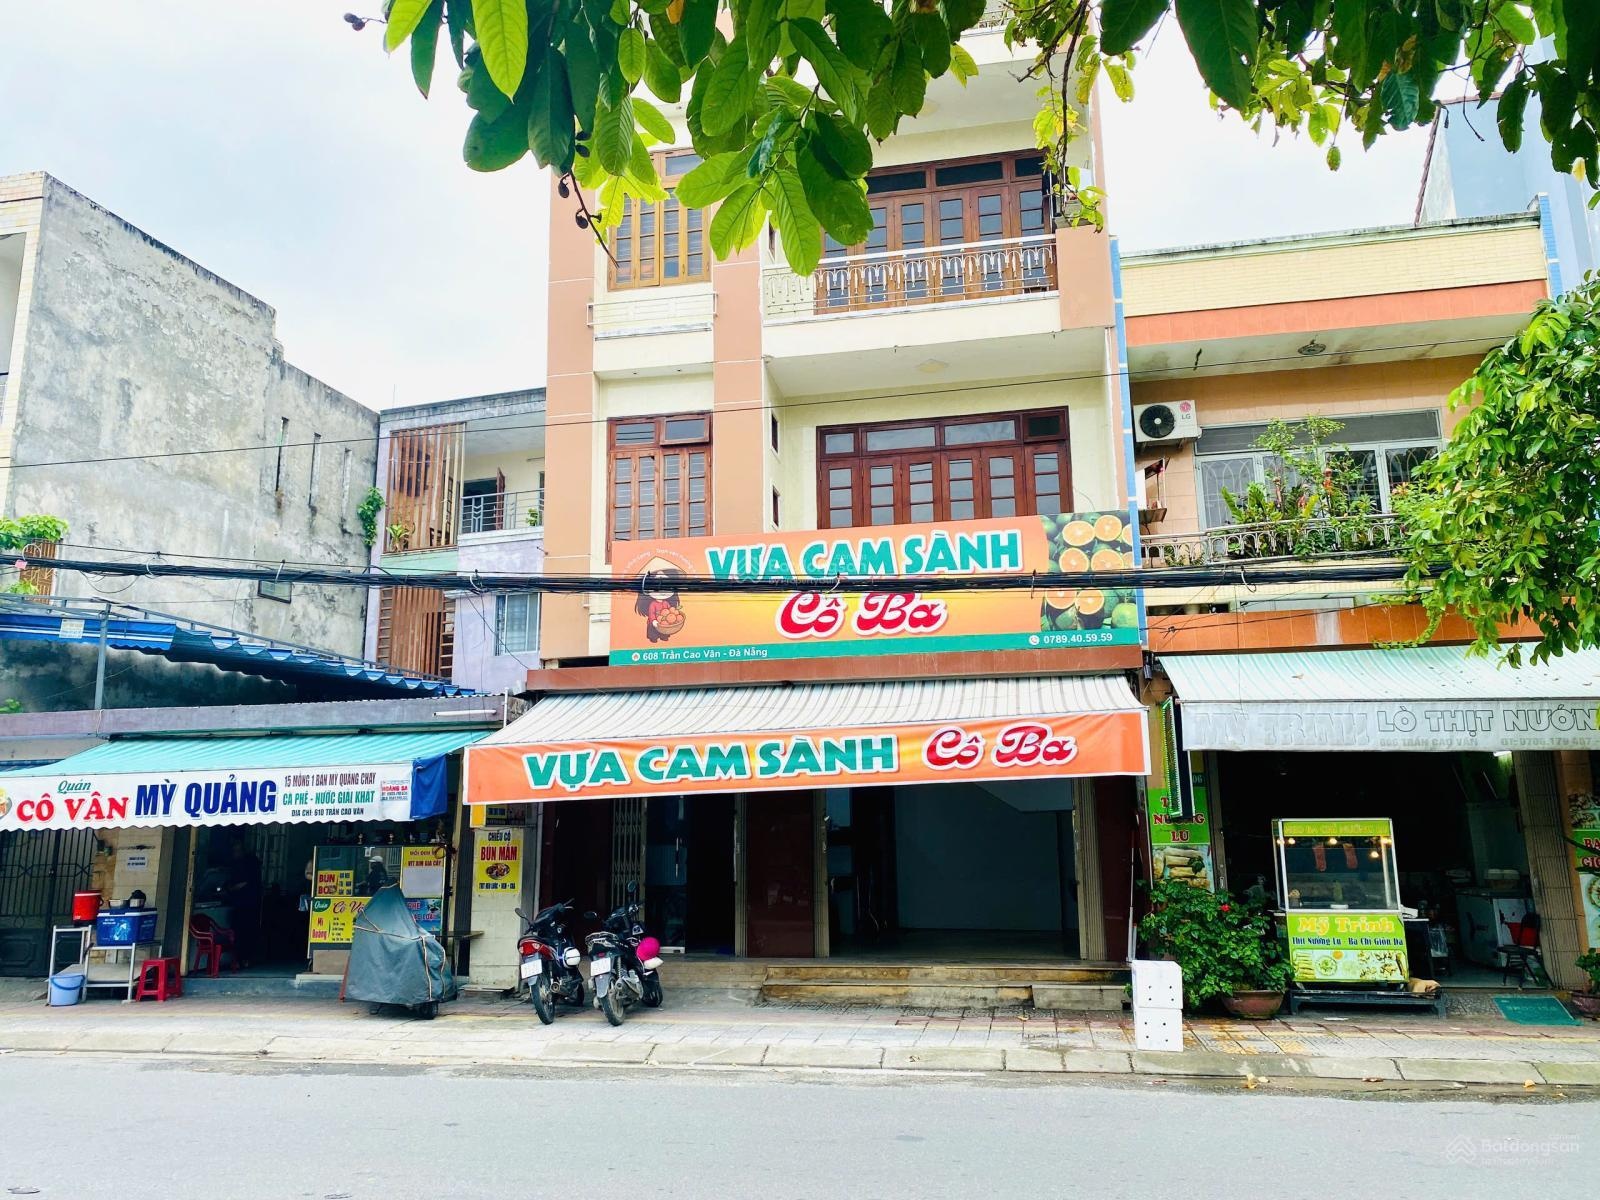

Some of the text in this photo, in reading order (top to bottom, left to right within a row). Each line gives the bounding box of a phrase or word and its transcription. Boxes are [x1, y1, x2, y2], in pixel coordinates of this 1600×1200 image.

[803, 540, 895, 579] CAM
[904, 533, 1019, 573] SÀNH
[780, 591, 842, 634] Cô
[643, 653, 659, 661] 608
[683, 651, 701, 659] Cao
[703, 648, 720, 659] Vân
[1043, 633, 1113, 645] 0789.40.59.59
[1376, 706, 1417, 733] LÒ
[1425, 710, 1494, 737] THỊT
[926, 725, 1073, 767] Cô Ba
[526, 737, 894, 789] VỰA CAM SÀNH
[57, 779, 92, 794] Quán
[134, 773, 277, 818] MỲ QUẢNG
[16, 790, 129, 822] CÔ VÂN
[480, 844, 497, 861] BÚN
[1298, 916, 1330, 936] Mỹ
